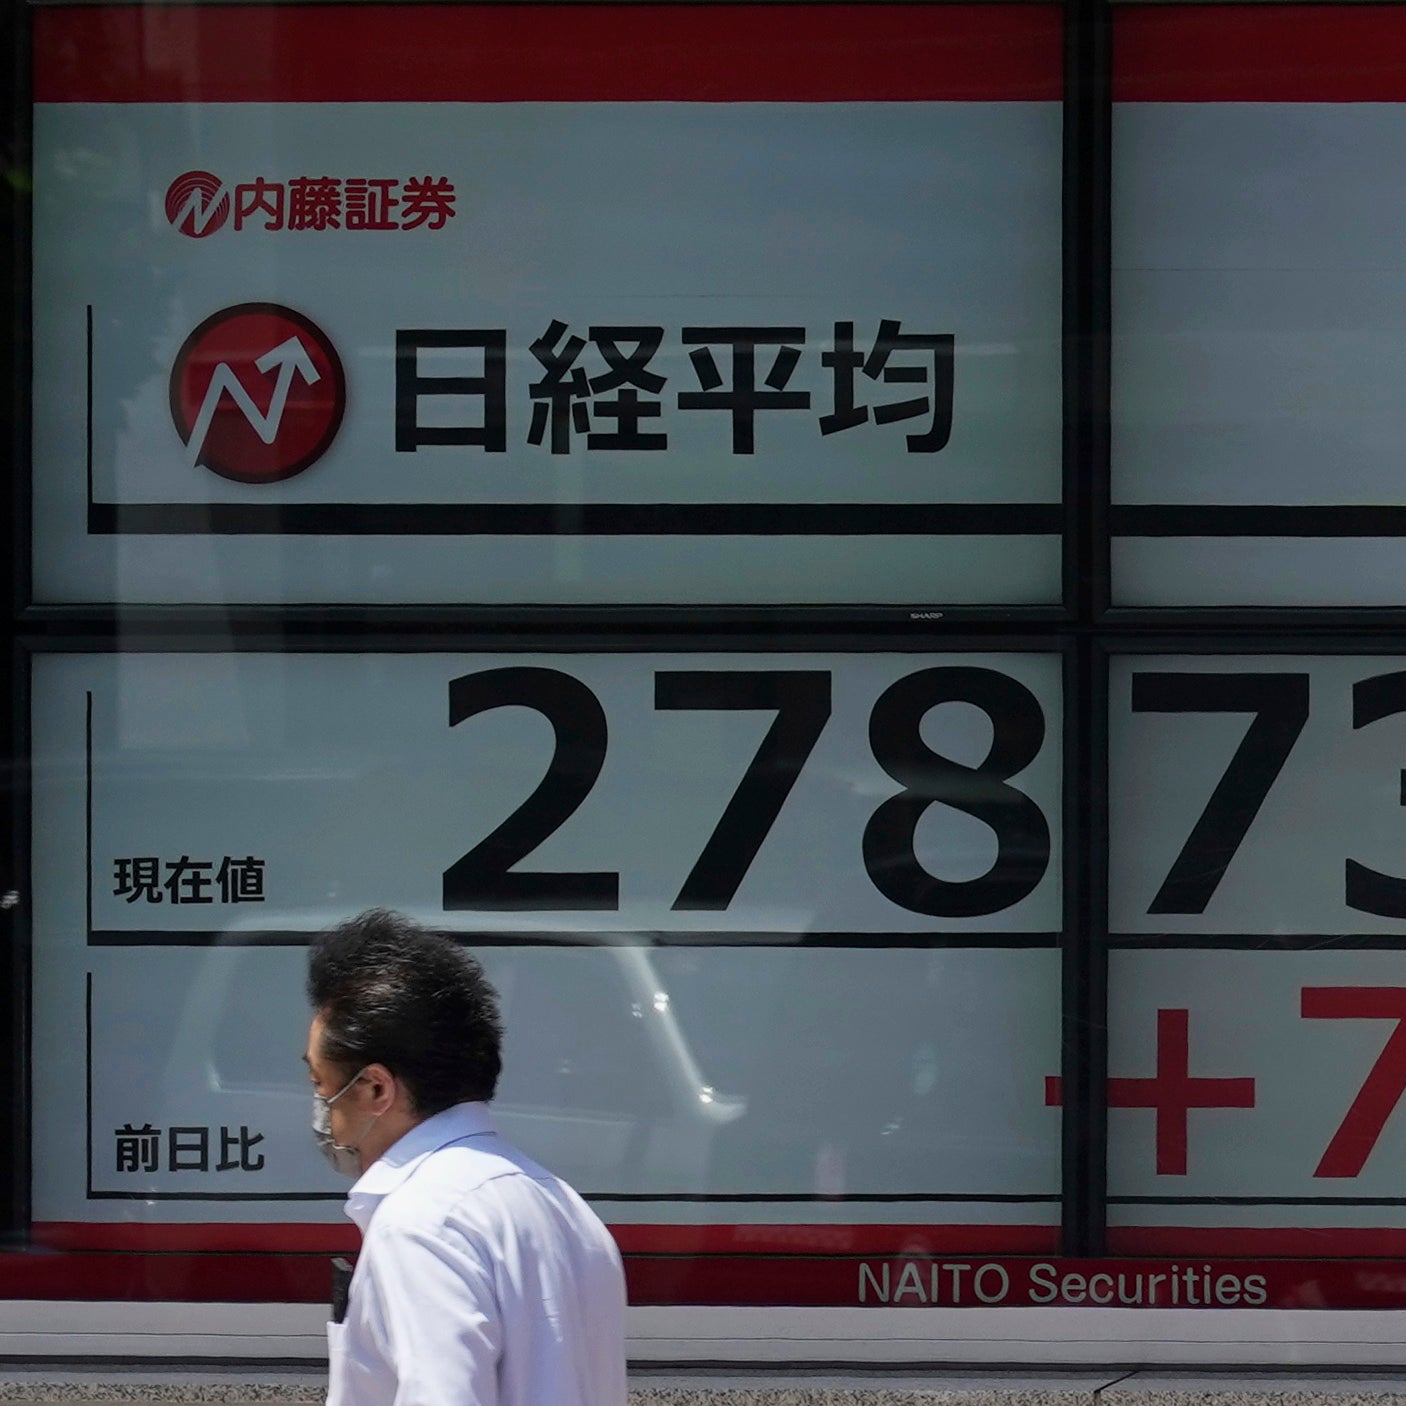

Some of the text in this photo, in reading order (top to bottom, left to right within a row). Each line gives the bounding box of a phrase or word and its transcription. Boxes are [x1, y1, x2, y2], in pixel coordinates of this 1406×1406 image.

[233, 175, 457, 232] 内藤証券
[395, 319, 956, 455] 日経平均
[112, 855, 267, 905] 現在値
[114, 1123, 266, 1173] 前日比
[858, 1262, 1268, 1305] NAITO Securities
